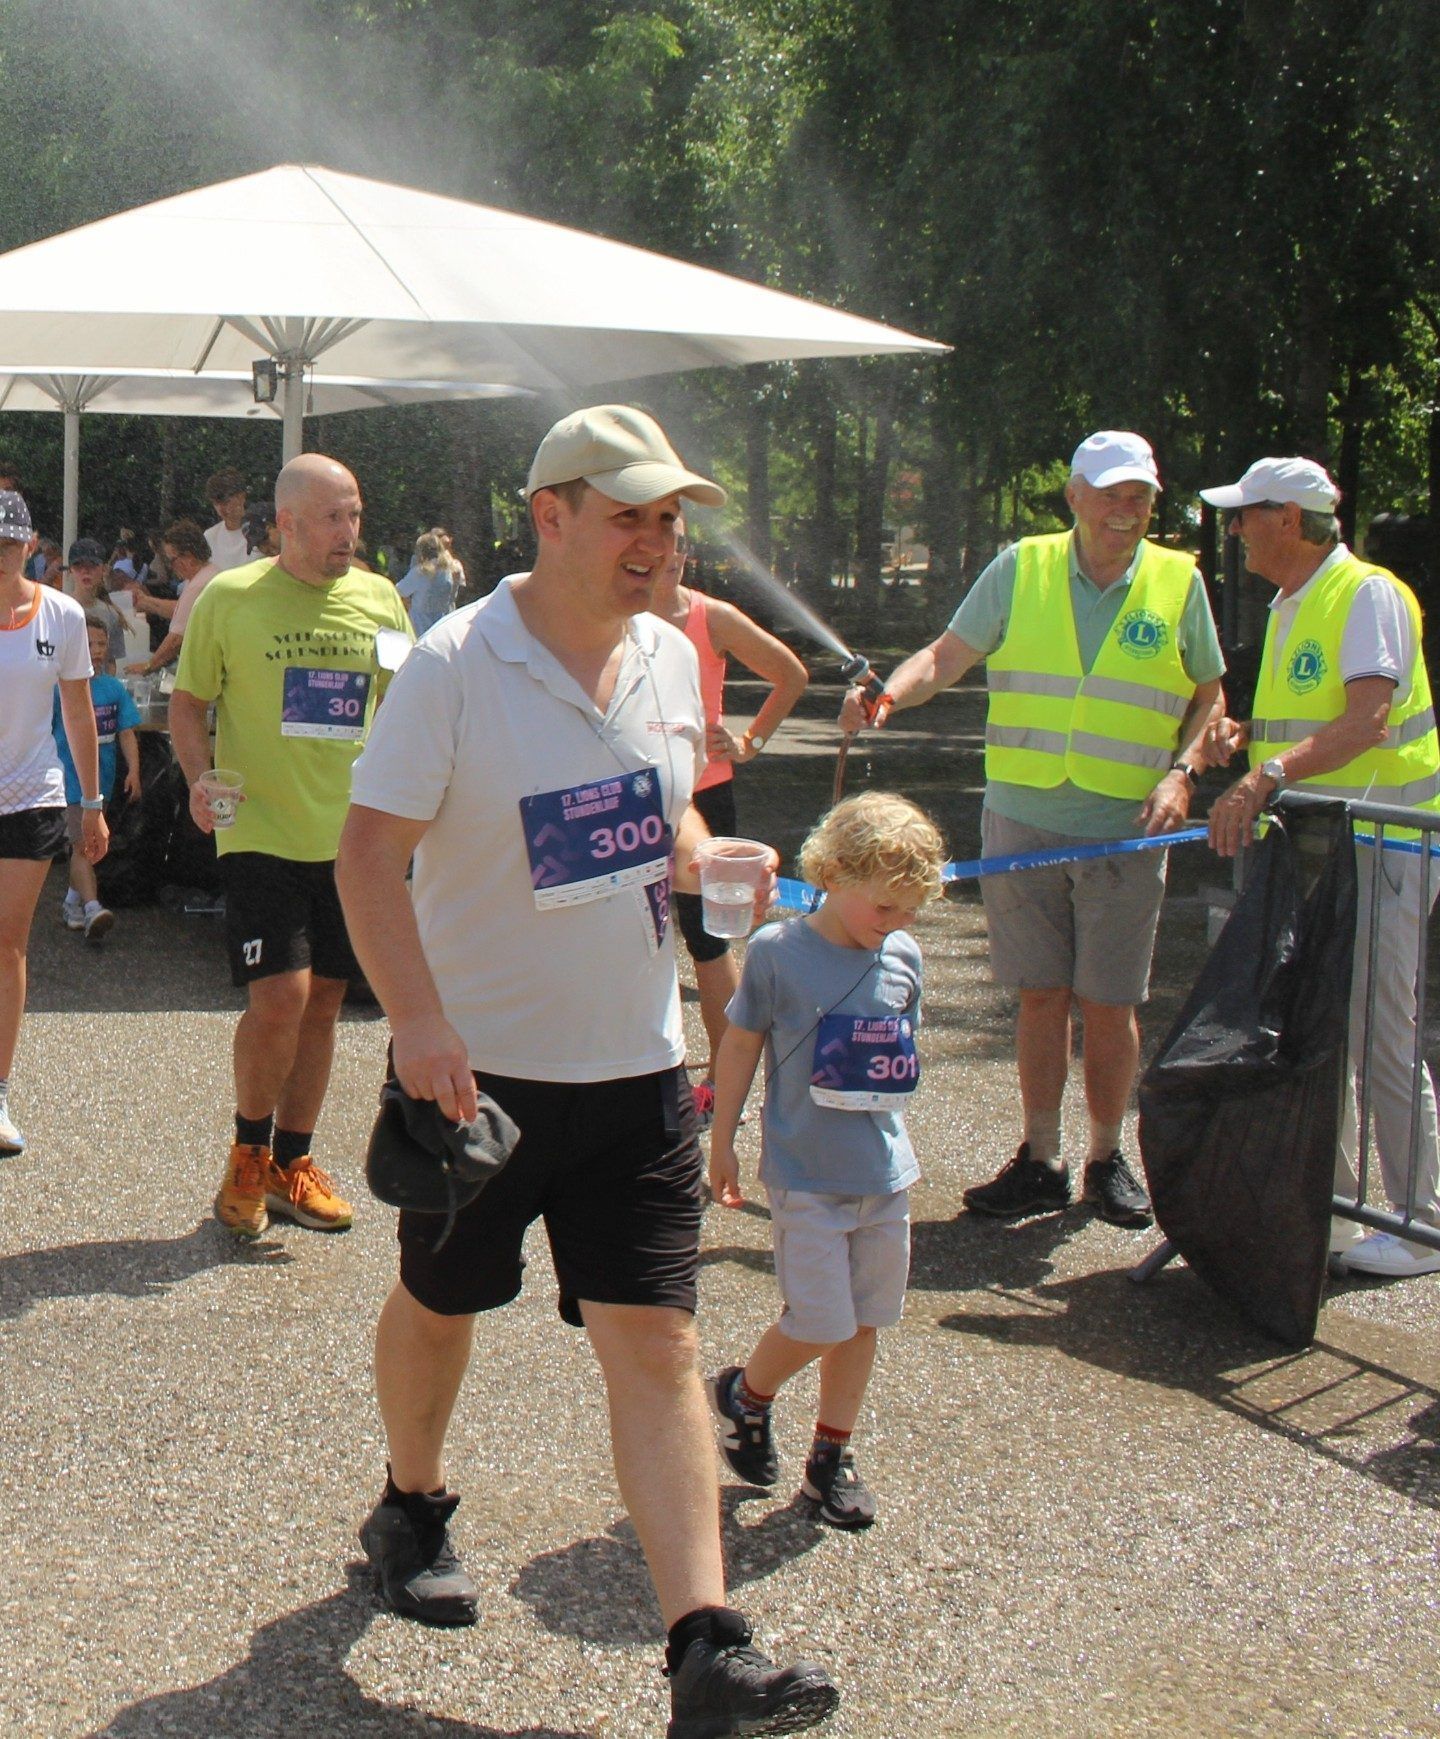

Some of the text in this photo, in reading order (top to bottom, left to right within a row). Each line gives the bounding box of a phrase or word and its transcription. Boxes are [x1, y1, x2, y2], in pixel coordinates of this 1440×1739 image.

[1134, 623, 1149, 644] L
[1297, 656, 1311, 676] L
[328, 697, 360, 718] 30
[575, 787, 600, 804] LIONS
[600, 781, 622, 797] CLUB
[563, 796, 619, 821] STUNDENLAUF
[589, 815, 662, 859] 300
[242, 939, 264, 967] 27
[866, 1054, 916, 1080] 301
